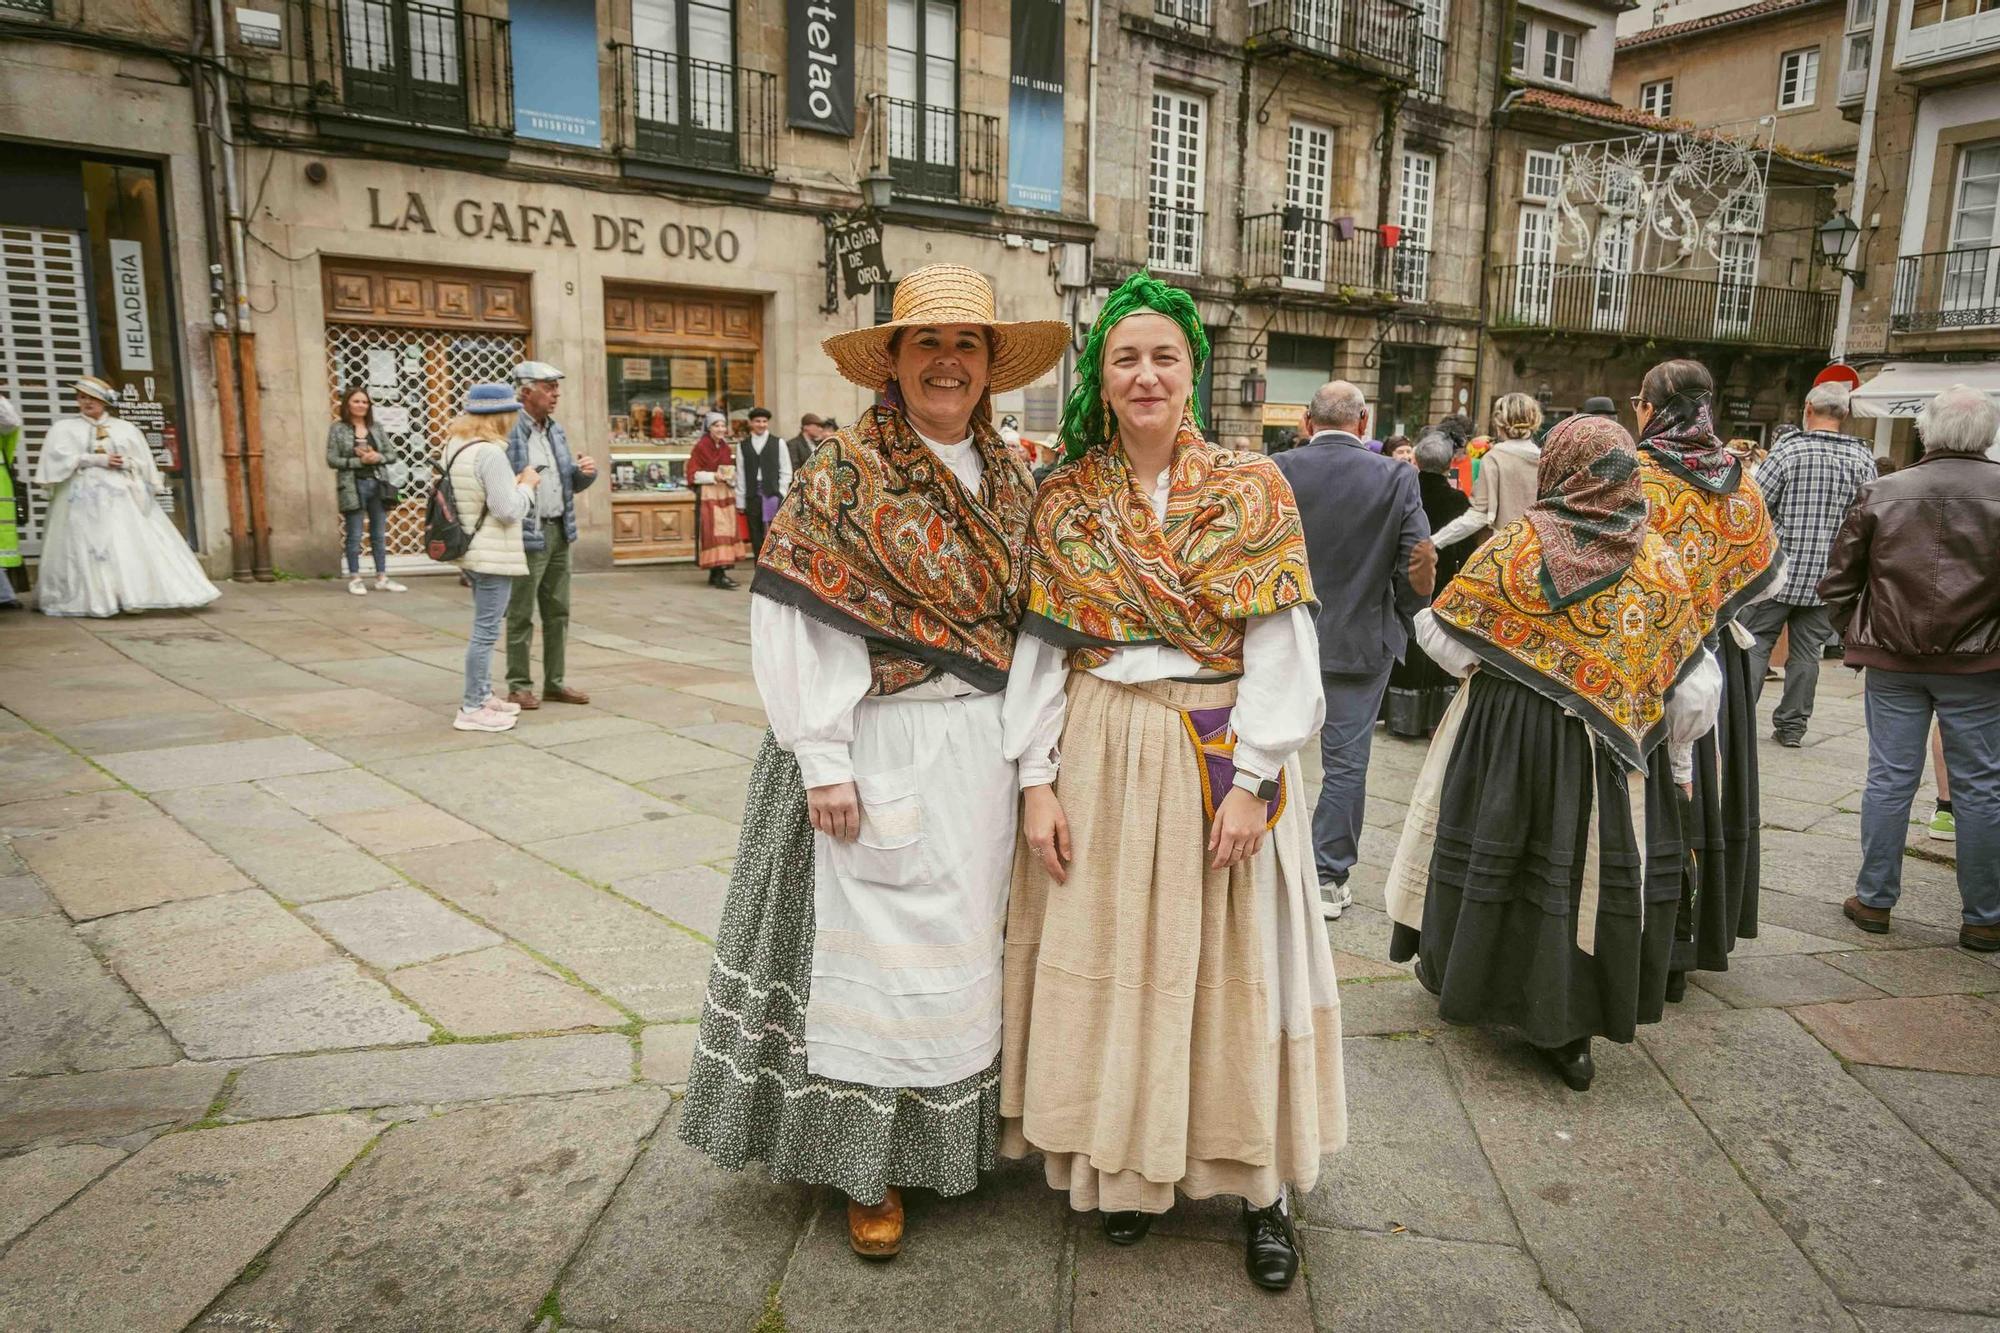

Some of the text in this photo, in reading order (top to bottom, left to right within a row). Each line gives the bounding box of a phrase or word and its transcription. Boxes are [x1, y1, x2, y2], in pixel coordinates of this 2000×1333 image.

[807, 0, 838, 119] telao
[366, 187, 740, 264] LA GAFA DE ORO
[836, 226, 880, 254] LA GAFA
[925, 241, 932, 254] 9
[848, 251, 864, 269] DE
[857, 265, 880, 285] ORO
[565, 281, 574, 296] 9
[116, 254, 145, 358] HELADERÍA
[1851, 325, 1882, 335] PRAZA
[1846, 340, 1883, 349] TOURAL
